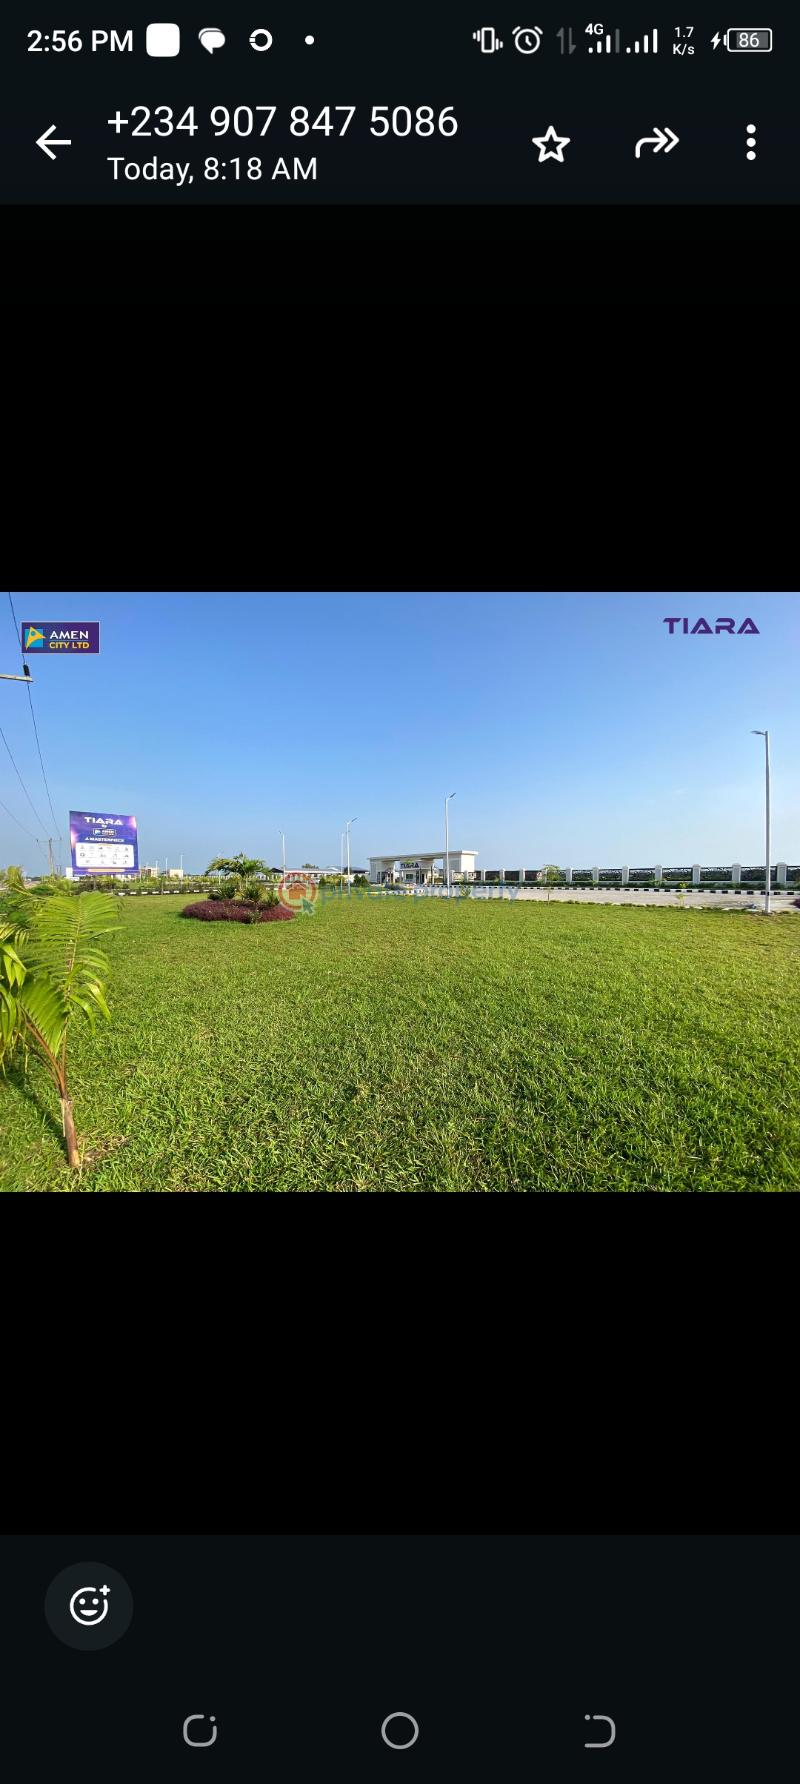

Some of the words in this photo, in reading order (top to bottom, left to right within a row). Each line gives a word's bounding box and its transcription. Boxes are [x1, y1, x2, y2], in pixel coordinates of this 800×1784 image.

[584, 22, 604, 36] 4G
[674, 26, 694, 38] 1.7
[27, 29, 83, 53] 2:56
[91, 29, 133, 52] PM
[738, 32, 760, 48] 86
[672, 43, 695, 56] K/s
[107, 105, 199, 137] +234
[210, 105, 277, 137] 907
[289, 105, 356, 137] 847
[369, 105, 458, 137] 5086
[106, 156, 194, 187] Today,
[203, 156, 263, 181] 8:18
[271, 157, 317, 180] AM
[84, 816, 123, 826] TIARA
